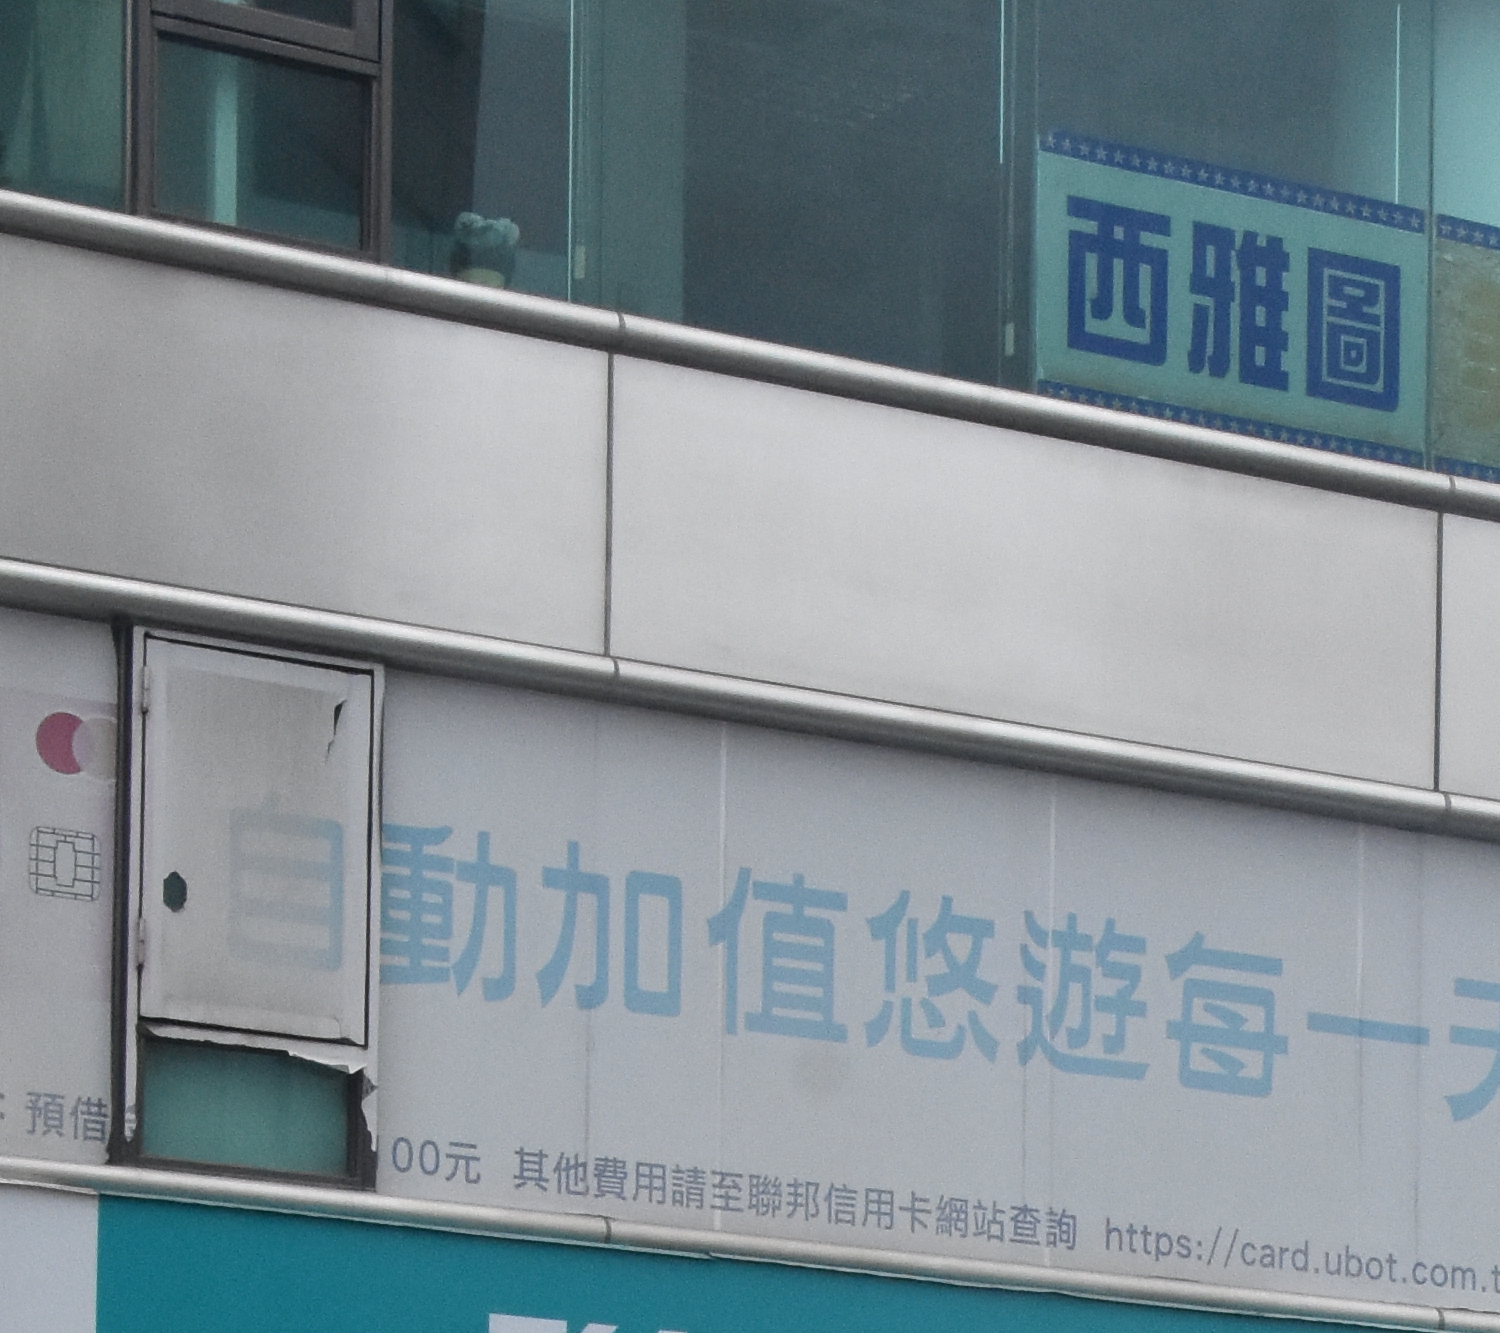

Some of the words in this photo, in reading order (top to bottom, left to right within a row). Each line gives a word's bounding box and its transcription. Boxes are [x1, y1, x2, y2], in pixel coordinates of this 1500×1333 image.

[1066, 195, 1401, 411] 西雅圖
[513, 1145, 1079, 1253] 其他費用請至聯邦信用卡網站查詢
